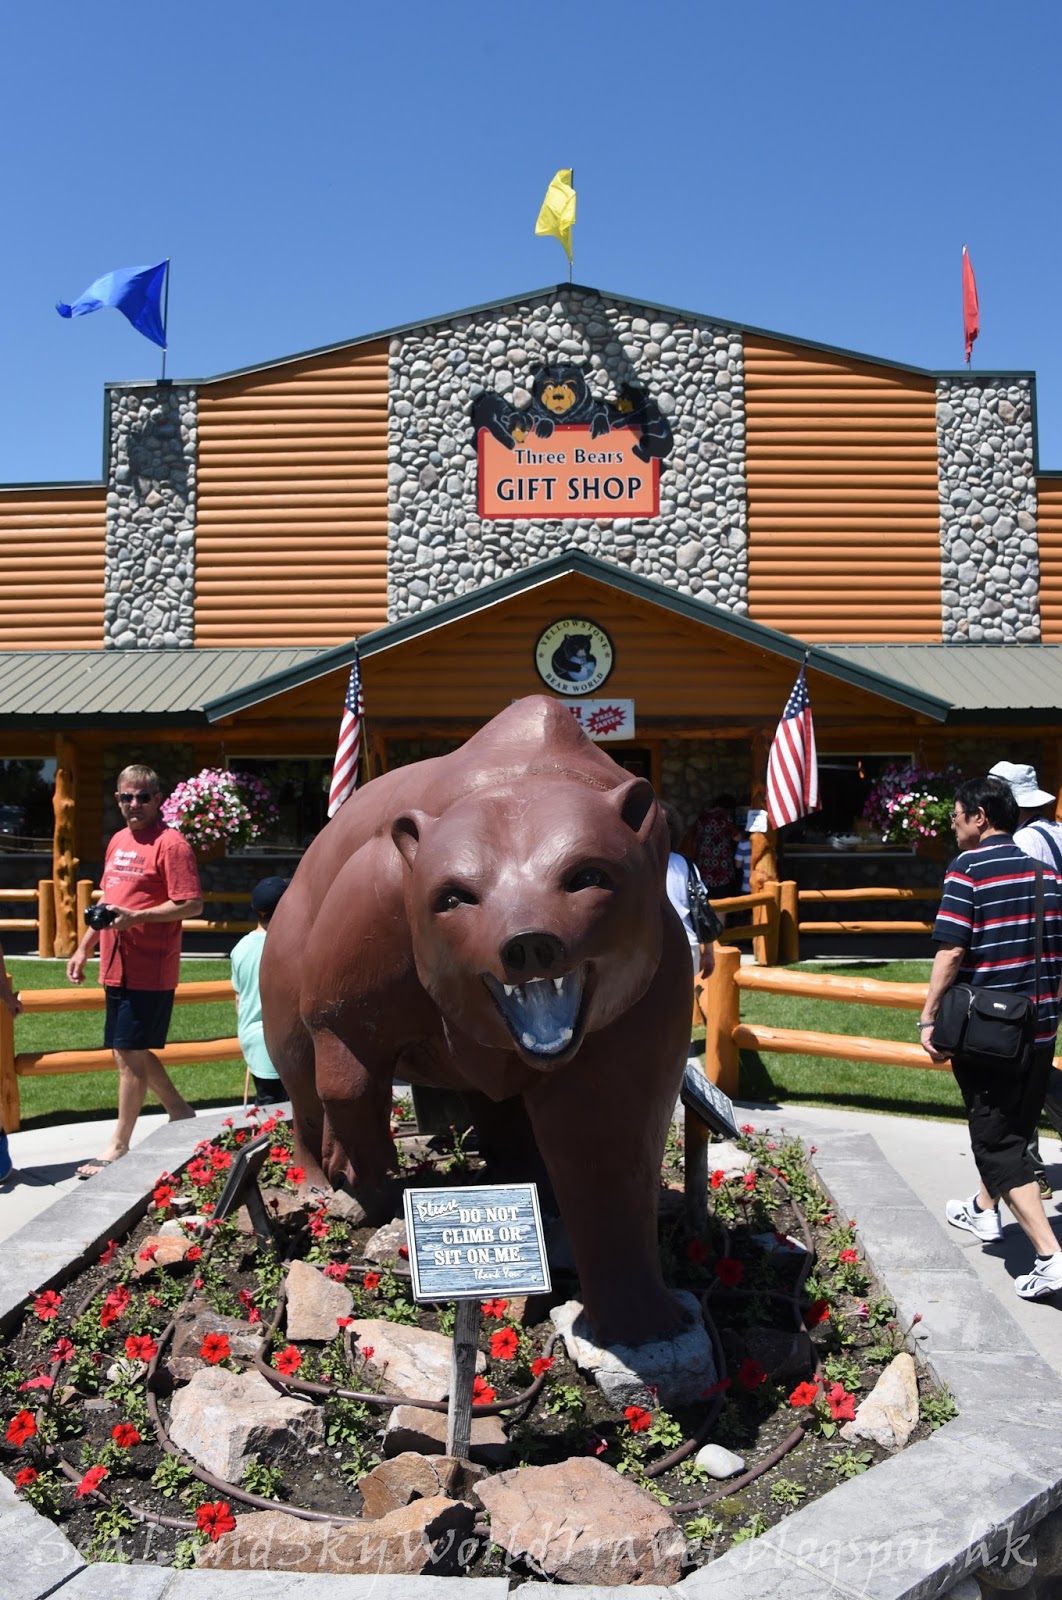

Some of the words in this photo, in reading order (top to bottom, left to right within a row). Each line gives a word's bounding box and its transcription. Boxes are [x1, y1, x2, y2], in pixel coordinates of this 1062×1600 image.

[515, 449, 565, 464] Three
[574, 448, 623, 464] Bears
[496, 478, 556, 501] GIFT
[568, 477, 642, 500] SHOP
[541, 620, 608, 649] YELLOWSTONE
[545, 673, 568, 691] BEAR
[572, 672, 604, 692] WORLD
[595, 711, 614, 722] FREE
[459, 1208, 481, 1223] DO
[485, 1206, 519, 1222] NOT
[442, 1228, 495, 1244] CLIMB
[499, 1227, 522, 1242] OR
[434, 1250, 462, 1265] SIT
[467, 1248, 490, 1263] ON
[494, 1247, 525, 1262] ME.
[473, 1268, 501, 1280] Thank
[502, 1267, 519, 1278] You
